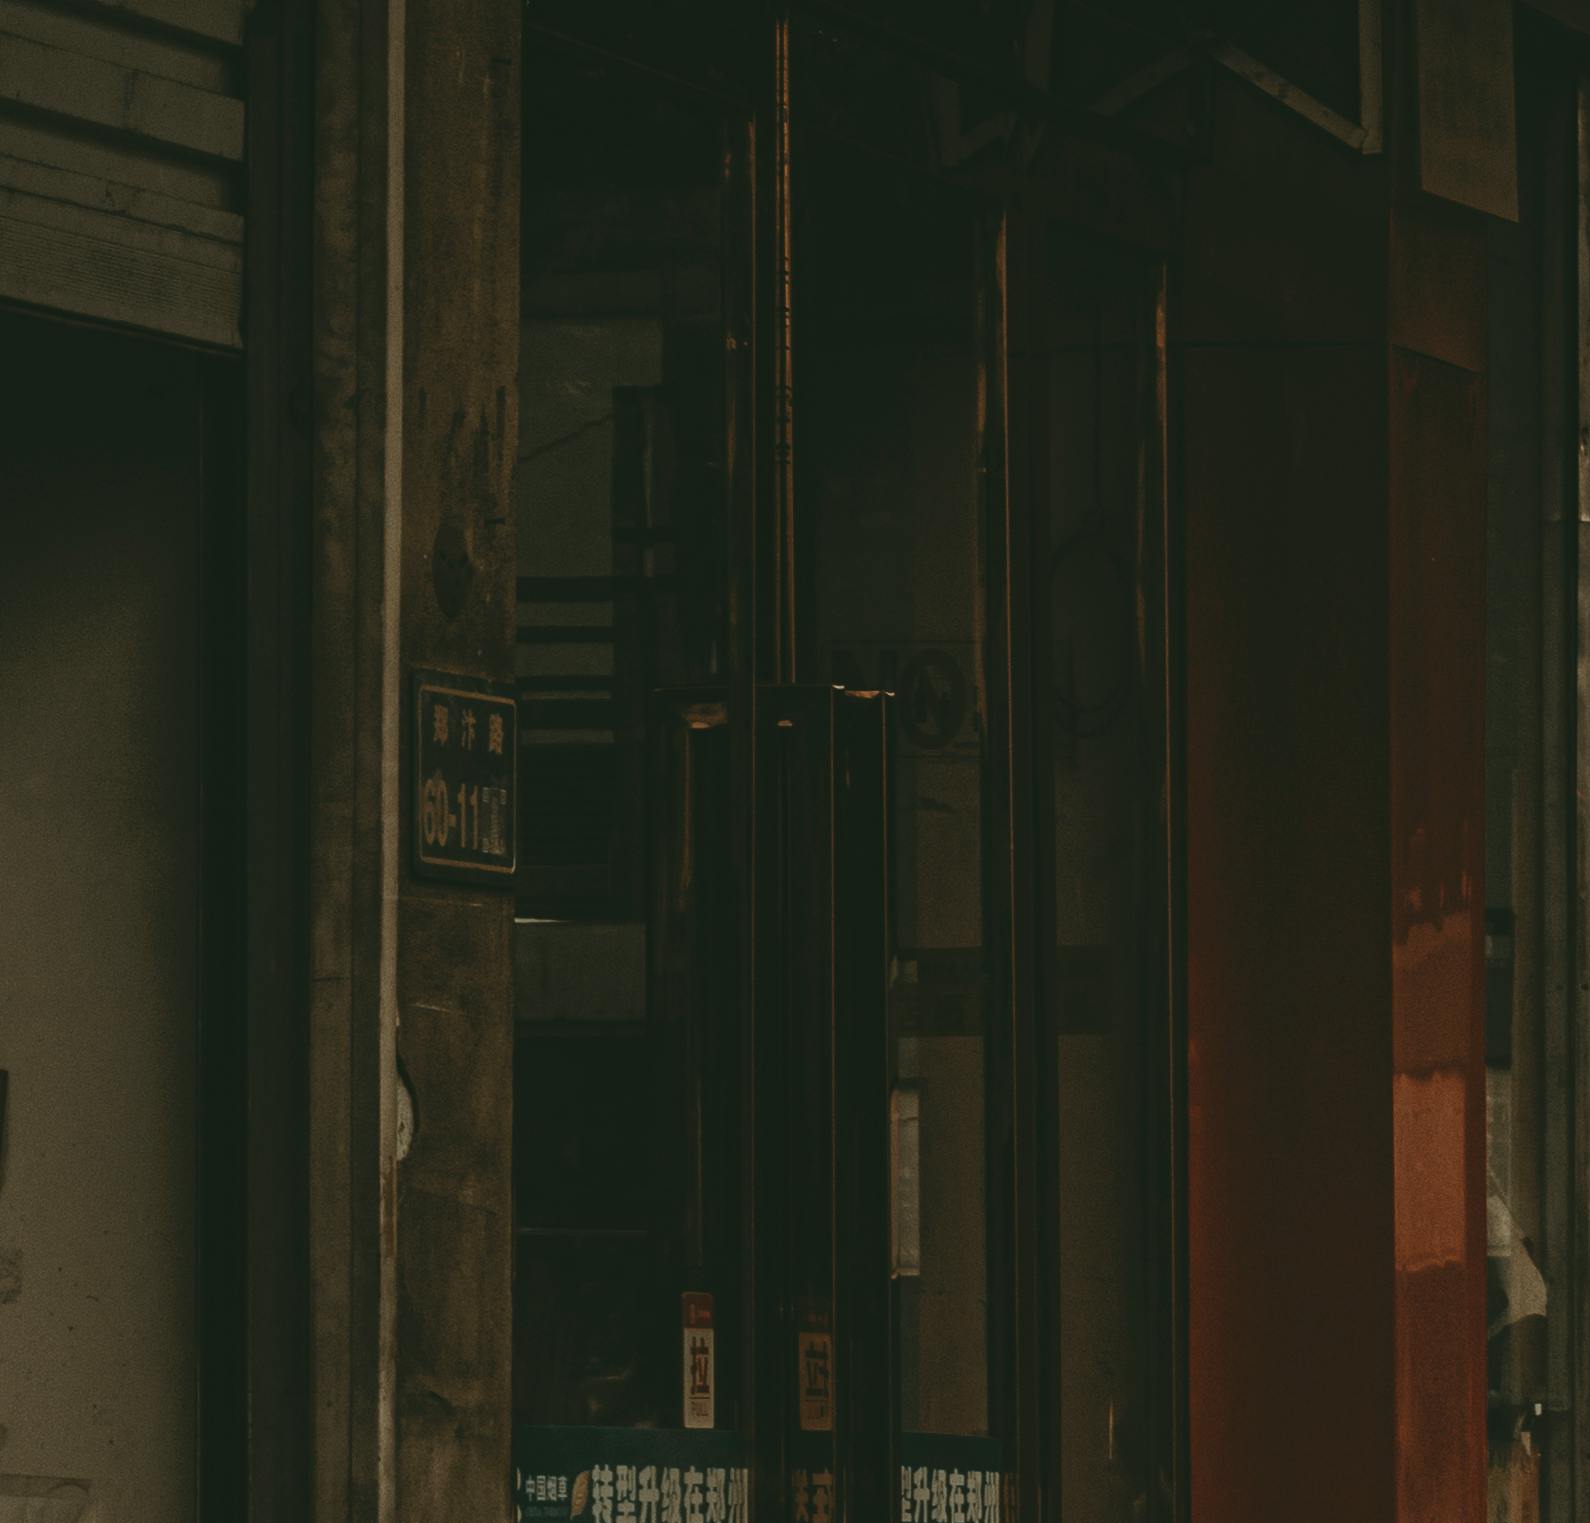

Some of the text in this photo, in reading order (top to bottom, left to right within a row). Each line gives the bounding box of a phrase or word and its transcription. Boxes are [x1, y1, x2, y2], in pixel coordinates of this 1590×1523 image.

[690, 1336, 710, 1396] 拉
[525, 1475, 568, 1503] 中国烟草
